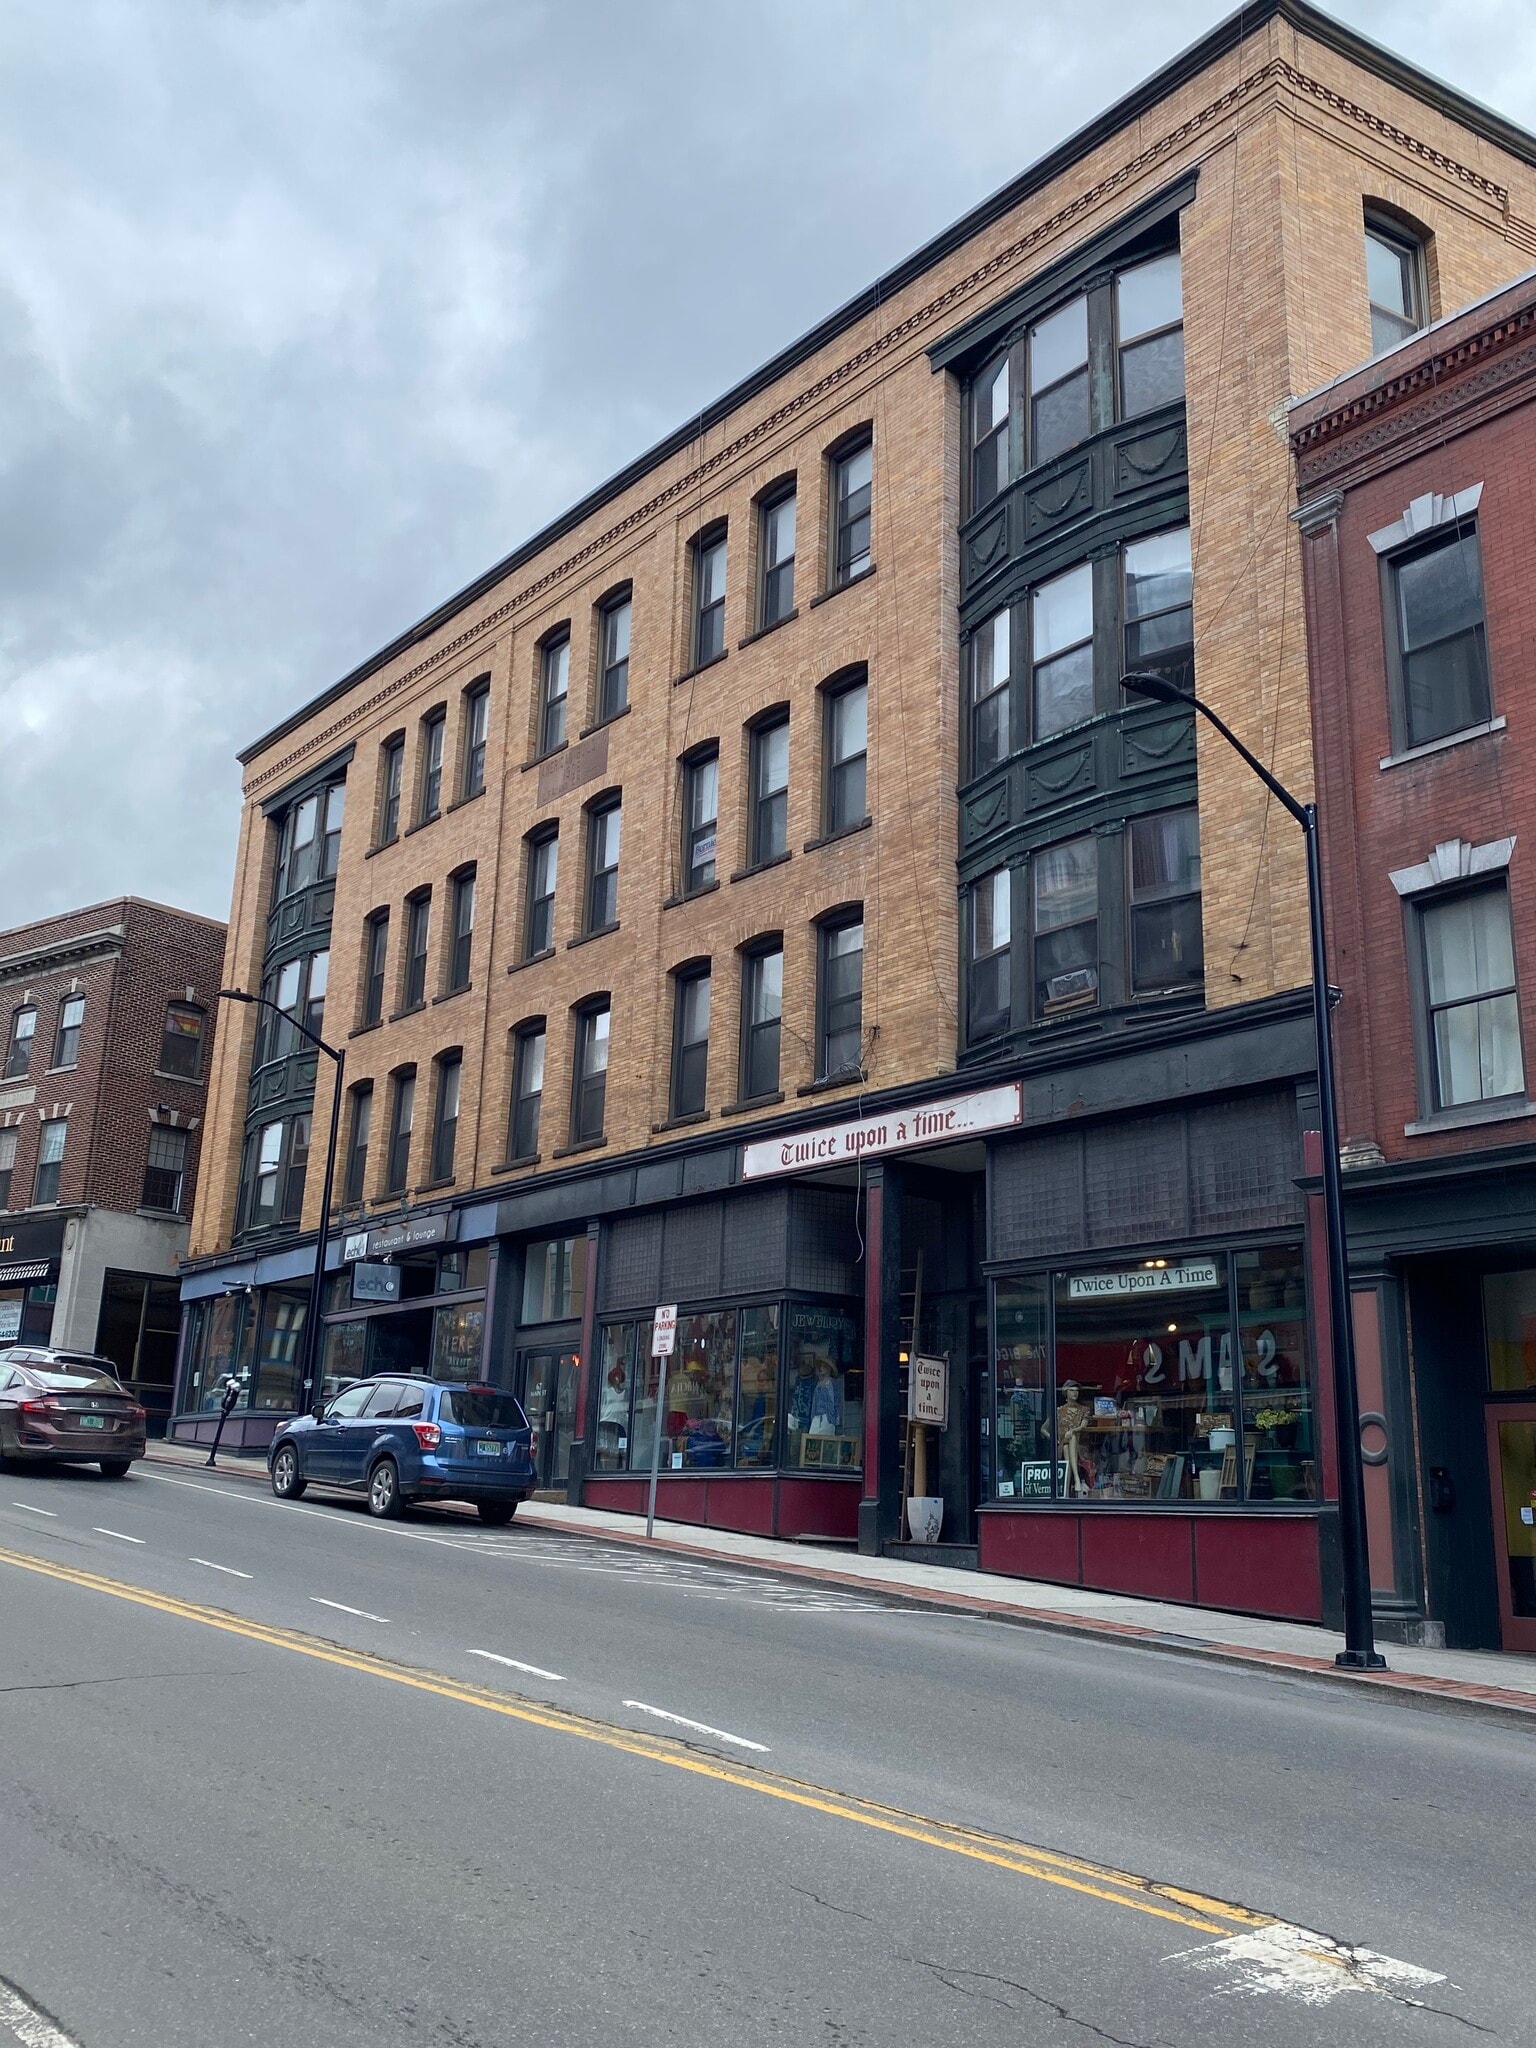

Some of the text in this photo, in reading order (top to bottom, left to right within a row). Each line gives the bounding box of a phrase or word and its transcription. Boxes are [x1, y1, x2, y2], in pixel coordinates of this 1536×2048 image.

[781, 1136, 837, 1166] Twice
[845, 1125, 888, 1153] upon
[896, 1121, 907, 1140] a
[373, 1228, 436, 1250] restaurant & lounge
[356, 1275, 395, 1293] echo
[1073, 1268, 1214, 1293] Twice Upon A Time
[661, 1310, 671, 1319] NO
[792, 1314, 845, 1329] JEWELRY
[655, 1321, 676, 1331] PARKING
[917, 1362, 941, 1377] Twice
[920, 1379, 940, 1391] upon
[926, 1392, 931, 1401] a
[1027, 1468, 1064, 1481] PROD
[1024, 1483, 1032, 1494] of
[1032, 1483, 1063, 1494] Vermt
